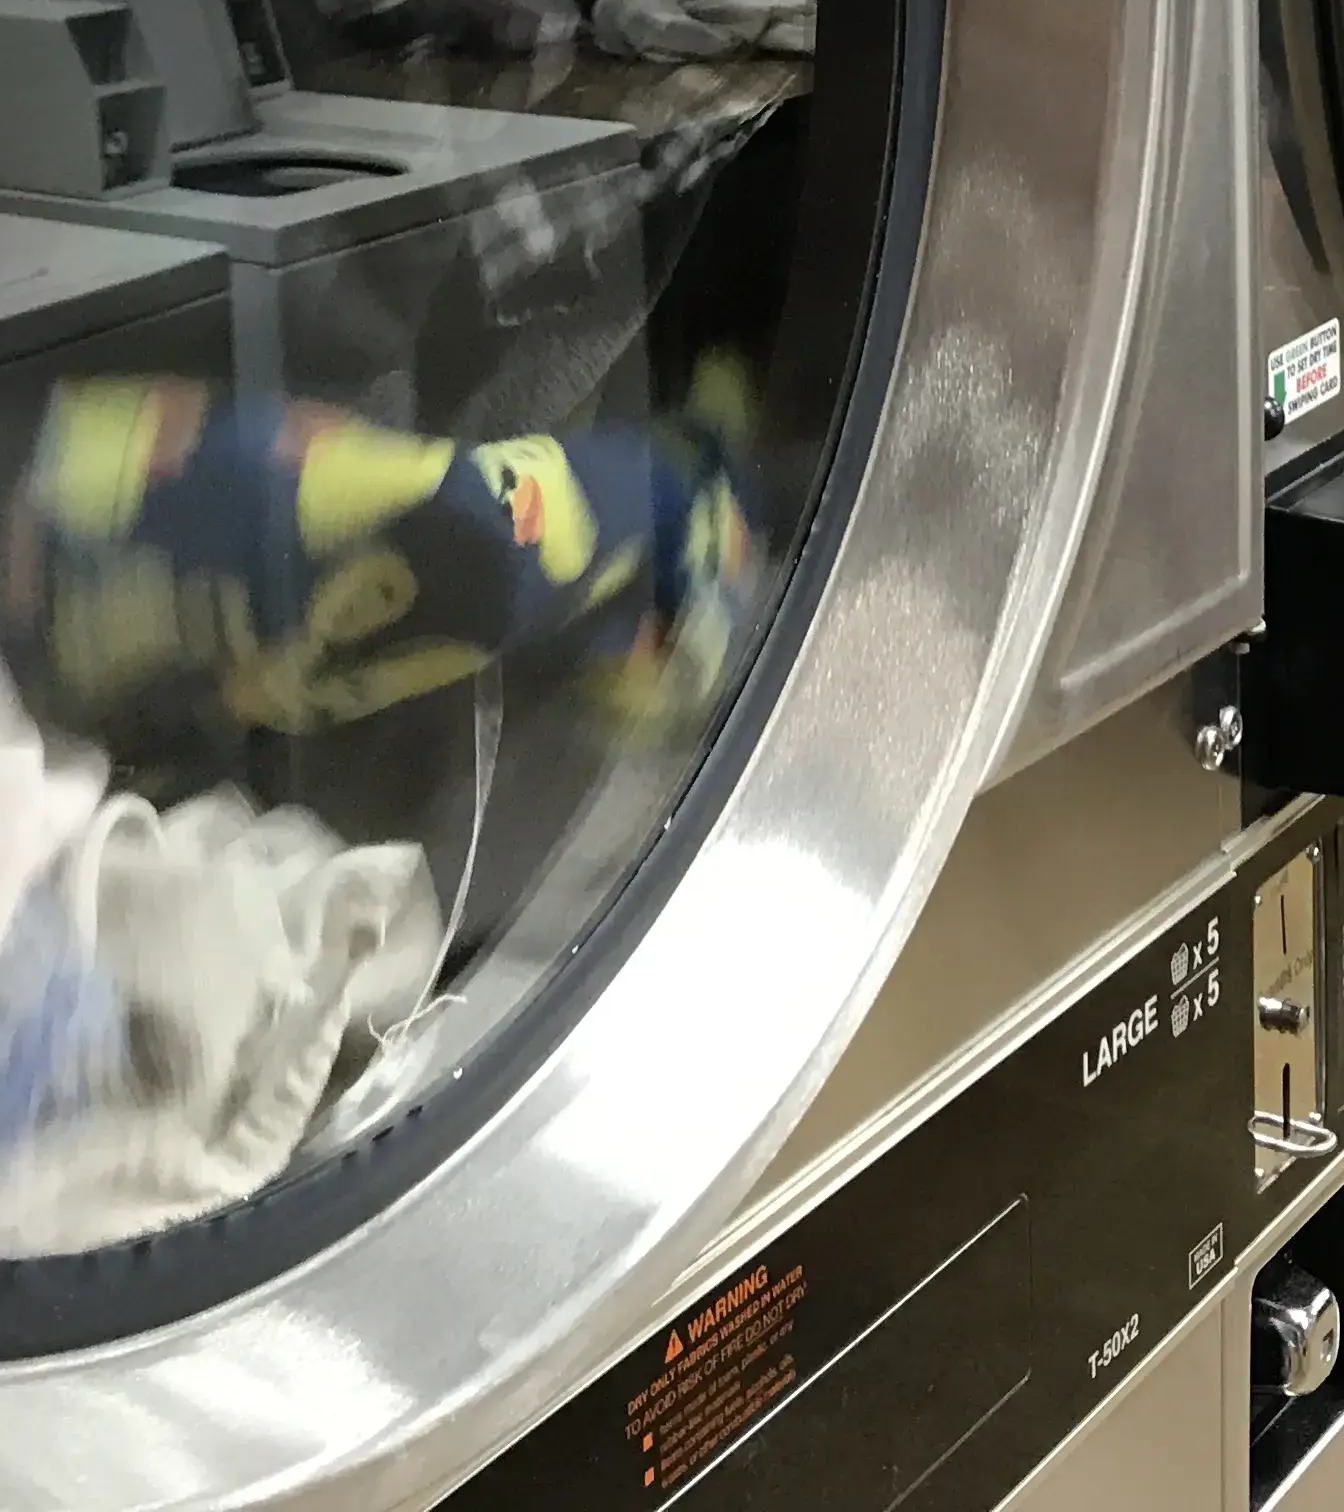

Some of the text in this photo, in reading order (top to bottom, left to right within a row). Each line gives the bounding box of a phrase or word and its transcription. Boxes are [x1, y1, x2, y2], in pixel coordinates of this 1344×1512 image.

[1310, 325, 1337, 349] BUTTON
[1296, 363, 1327, 393] BEFORE
[1297, 356, 1308, 373] SET
[1320, 375, 1338, 396] CARD
[1082, 994, 1159, 1087] LARGE
[1196, 1248, 1216, 1275] USA
[688, 1264, 769, 1342] WARNING
[628, 1264, 804, 1416] DRY ONLY FABRICS WASHED IN WATER
[1088, 1313, 1140, 1379] T-50X2
[625, 1418, 642, 1440] TO
[643, 1390, 676, 1429] AVOID
[677, 1367, 703, 1399] RISK
[704, 1358, 719, 1376] OF
[720, 1338, 743, 1362] FIRE
[745, 1323, 762, 1345] DO
[763, 1302, 783, 1331] NOT
